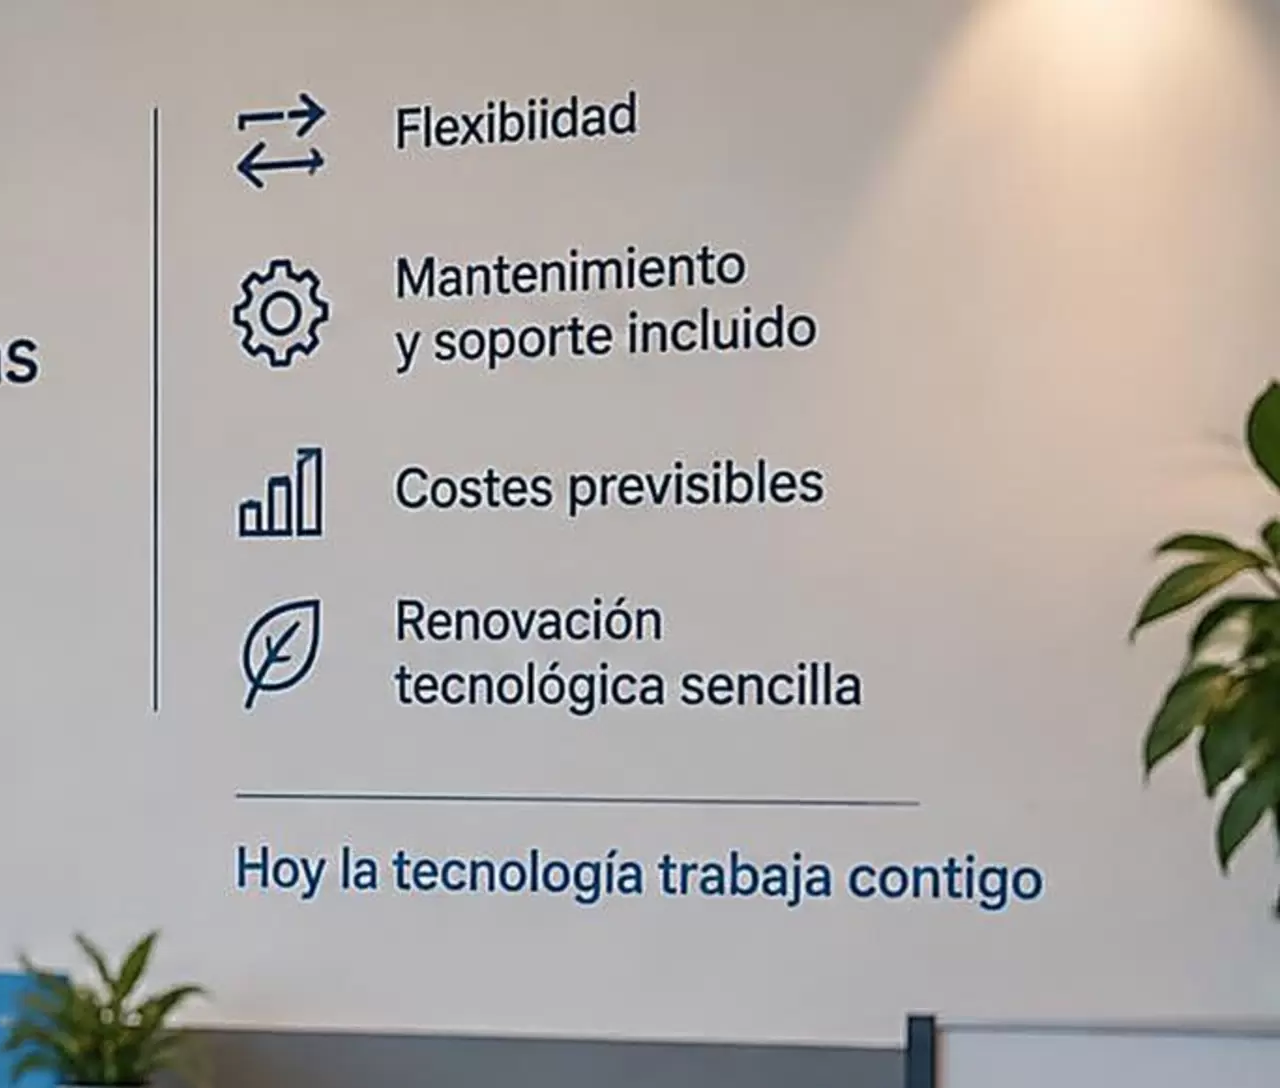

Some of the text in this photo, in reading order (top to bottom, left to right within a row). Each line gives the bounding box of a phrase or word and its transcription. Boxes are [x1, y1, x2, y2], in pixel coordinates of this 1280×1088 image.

[397, 90, 636, 150] Flexibiidad
[397, 245, 745, 299] Mantenimiento
[395, 304, 816, 374] y soporte incluido
[396, 458, 824, 518] Costes previsibles
[397, 596, 661, 641] Renovación
[394, 661, 861, 717] tecnológica sencilla
[238, 845, 1043, 911] Hoy la tecnología trabaja contigo
